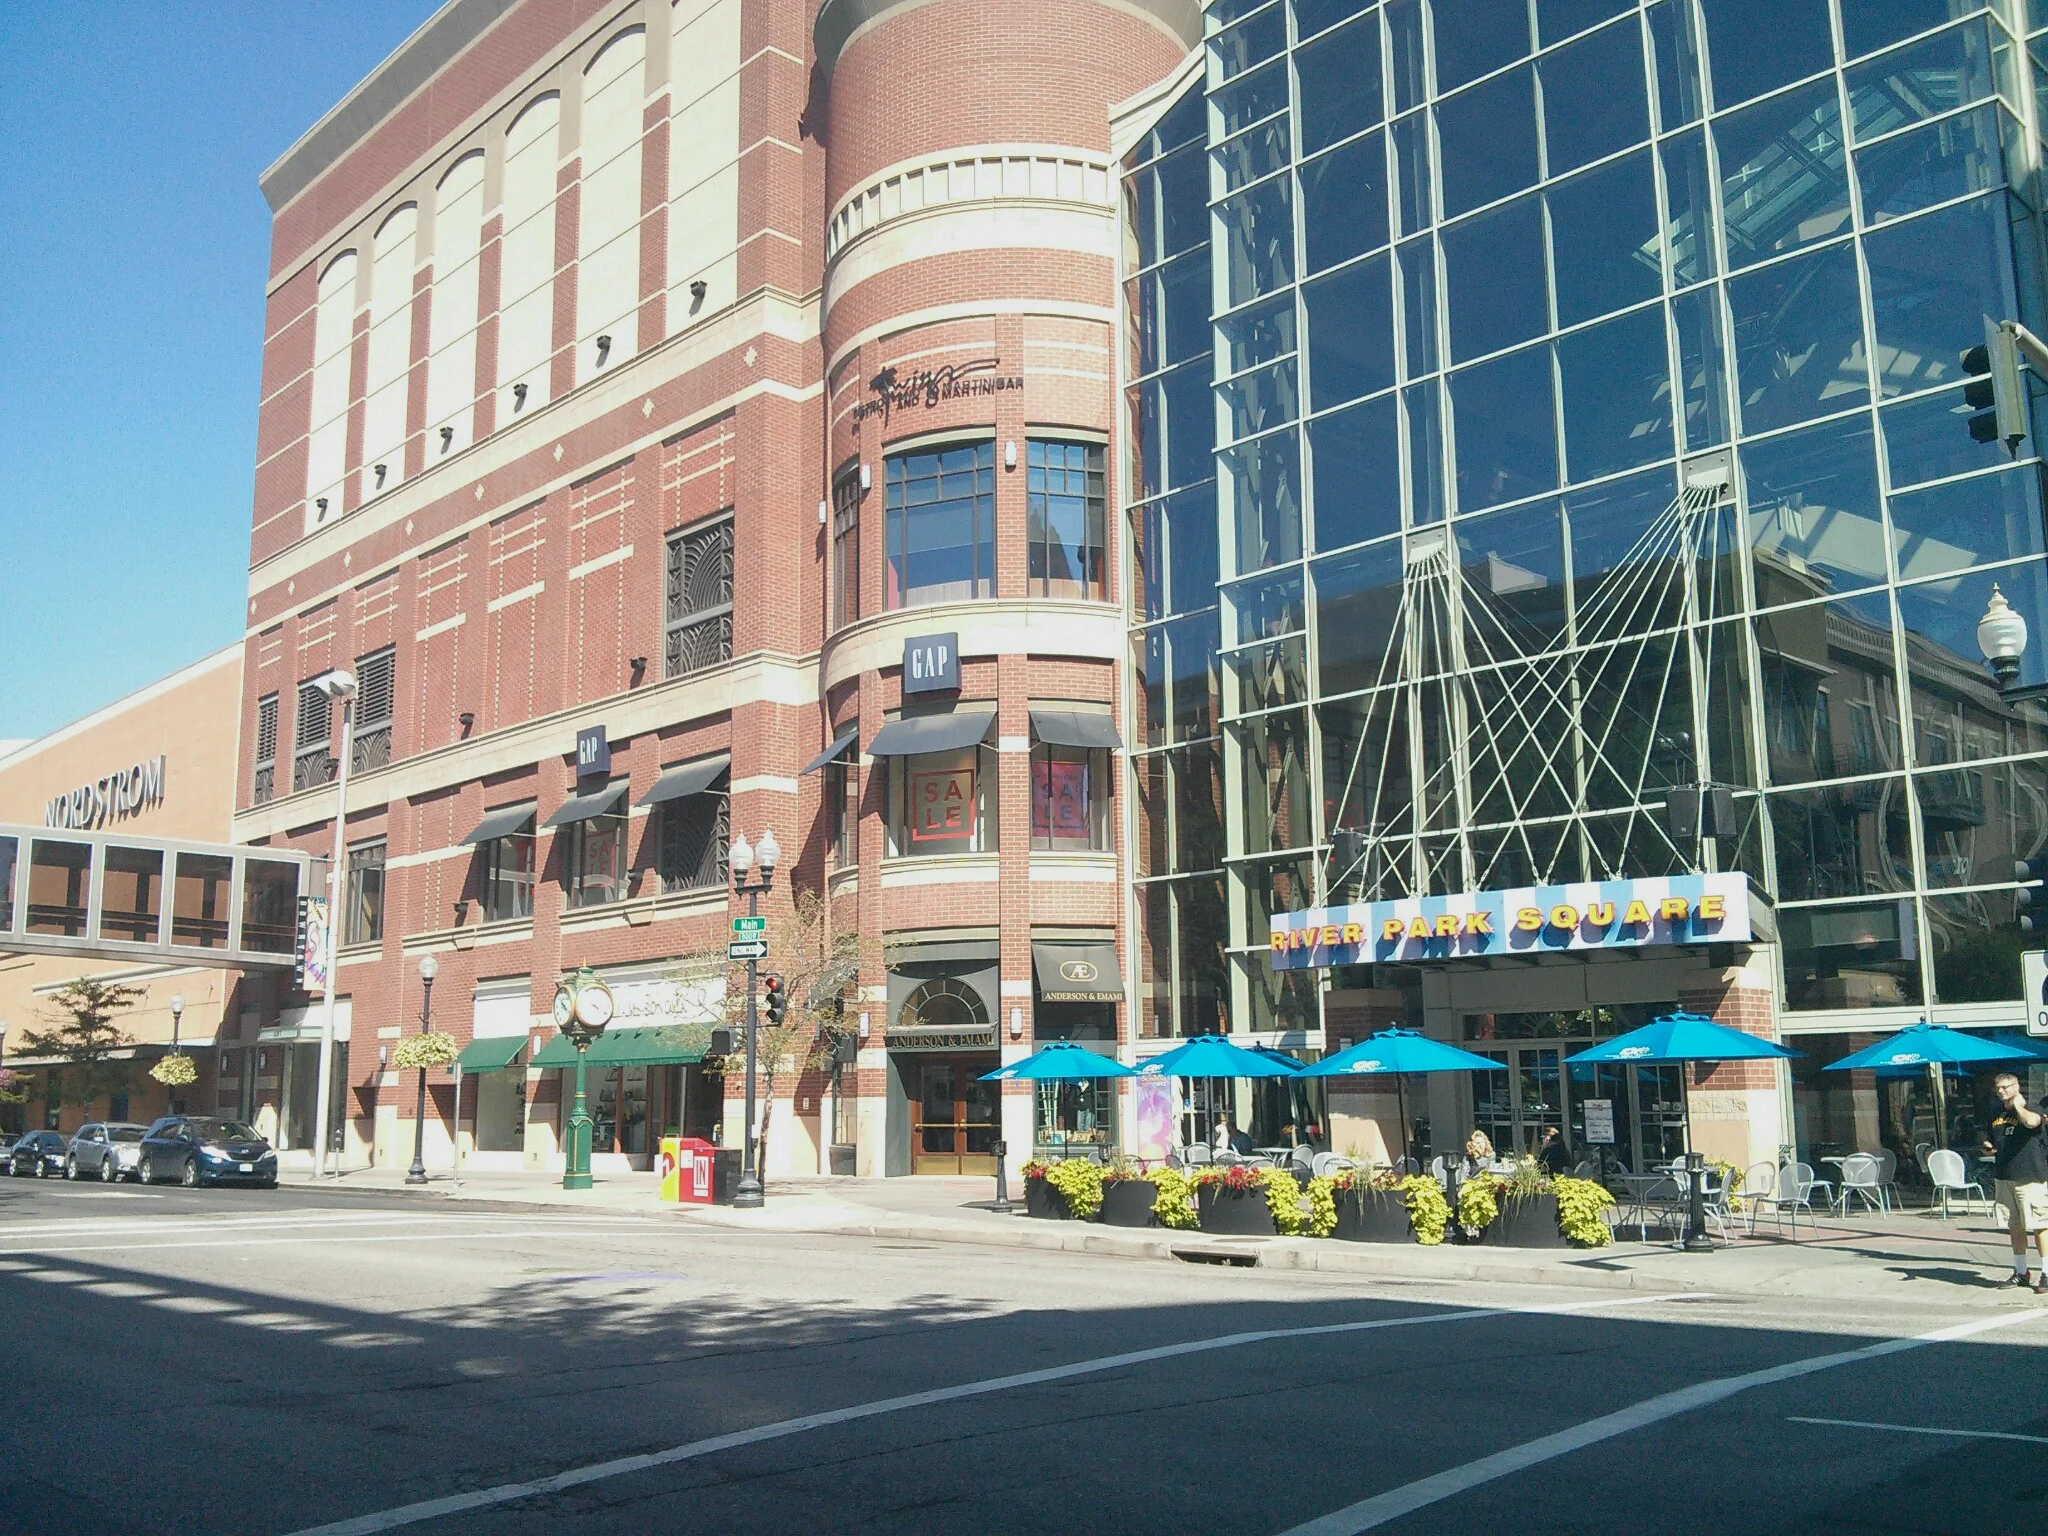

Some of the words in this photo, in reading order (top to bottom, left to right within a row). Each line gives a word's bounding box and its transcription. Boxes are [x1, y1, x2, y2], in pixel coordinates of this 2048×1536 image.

[942, 376, 995, 399] MARTINI
[996, 376, 1024, 390] BAR
[912, 645, 948, 679] GAP
[580, 736, 598, 765] GAP
[44, 755, 167, 829] NORDSTROM
[741, 919, 758, 930] Main
[1271, 922, 1364, 951] RIVER
[1383, 911, 1495, 941] PARK
[1516, 894, 1726, 931] SQUARE
[296, 900, 307, 983] DOWNTOWN
[1045, 992, 1087, 1000] ANDERSON
[1088, 992, 1095, 1000] &
[1096, 992, 1123, 1000] EMAMI
[892, 1034, 945, 1048] ANDERSON
[948, 1034, 957, 1047] &
[960, 1032, 995, 1047] EMAMI
